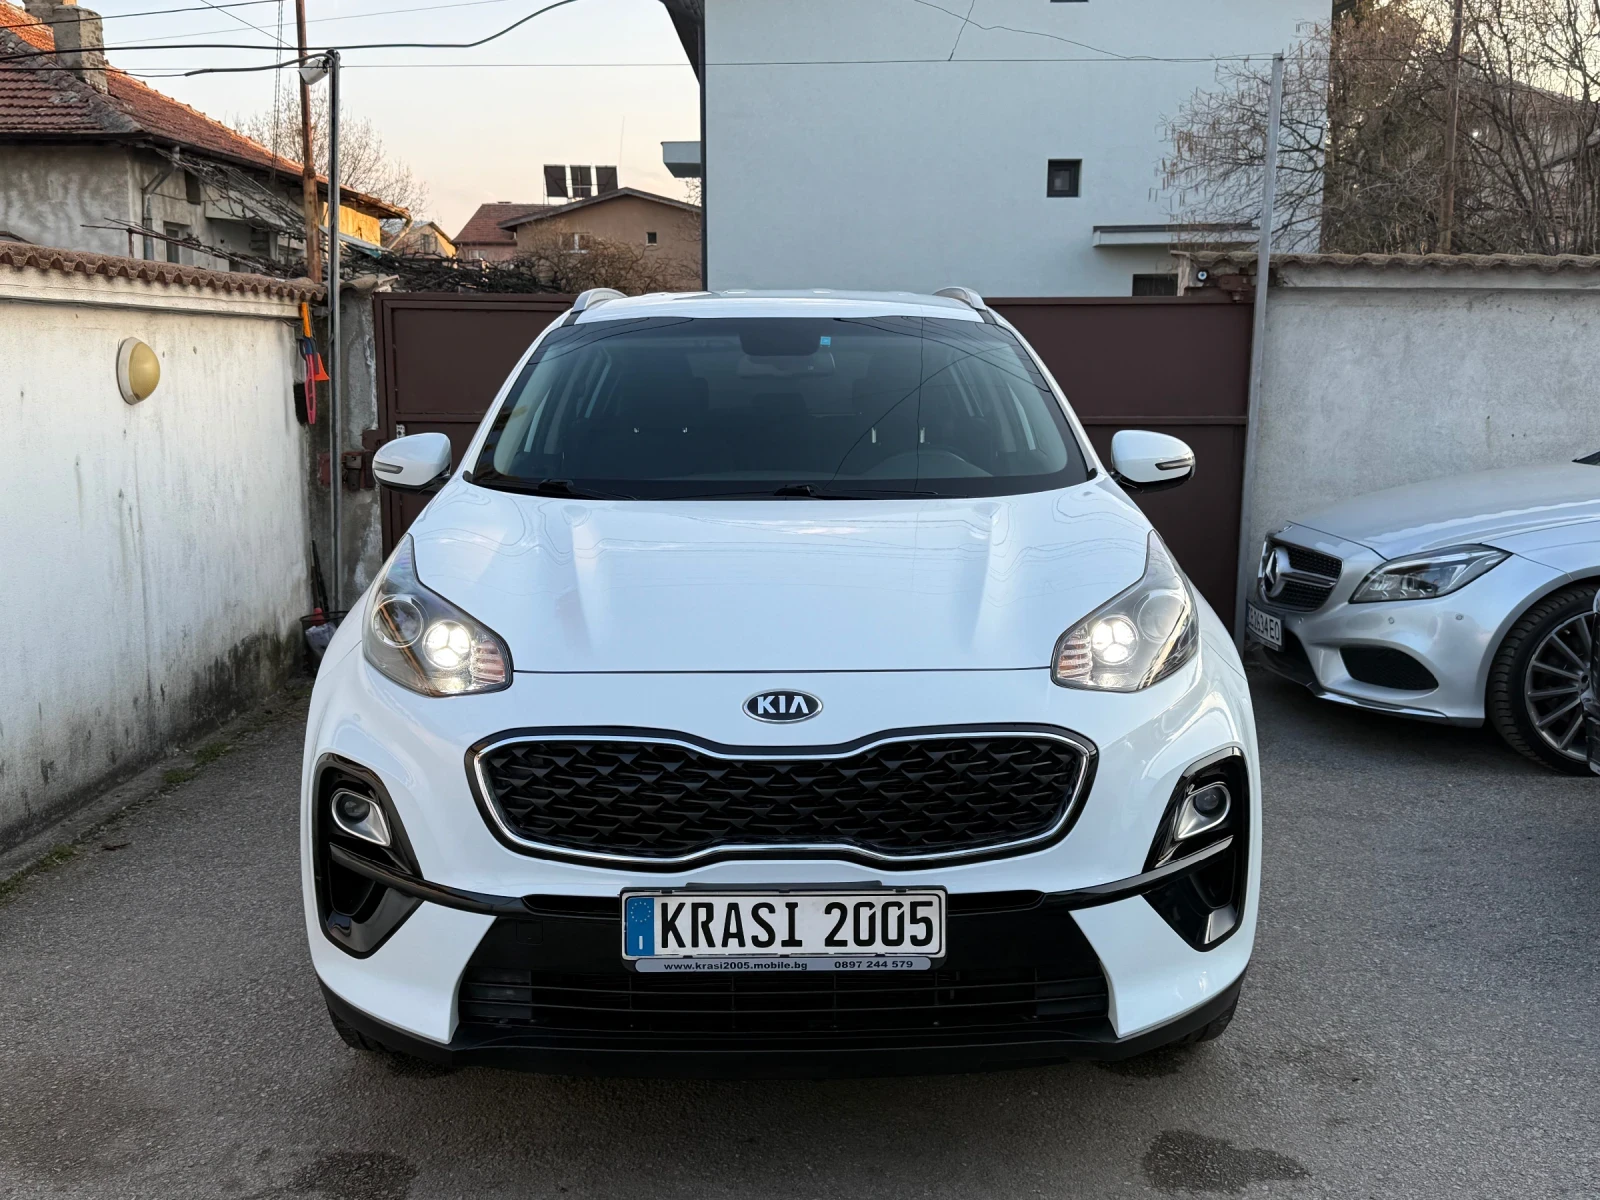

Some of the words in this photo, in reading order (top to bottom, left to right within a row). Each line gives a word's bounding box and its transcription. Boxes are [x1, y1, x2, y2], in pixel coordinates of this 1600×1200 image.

[757, 695, 809, 714] KIA
[660, 902, 803, 948] KRASI
[824, 900, 934, 947] 2005
[663, 961, 808, 971] www.krasi2005.mobile.bg
[834, 961, 862, 969] 0897
[866, 960, 888, 968] 244
[892, 960, 913, 968] 579
